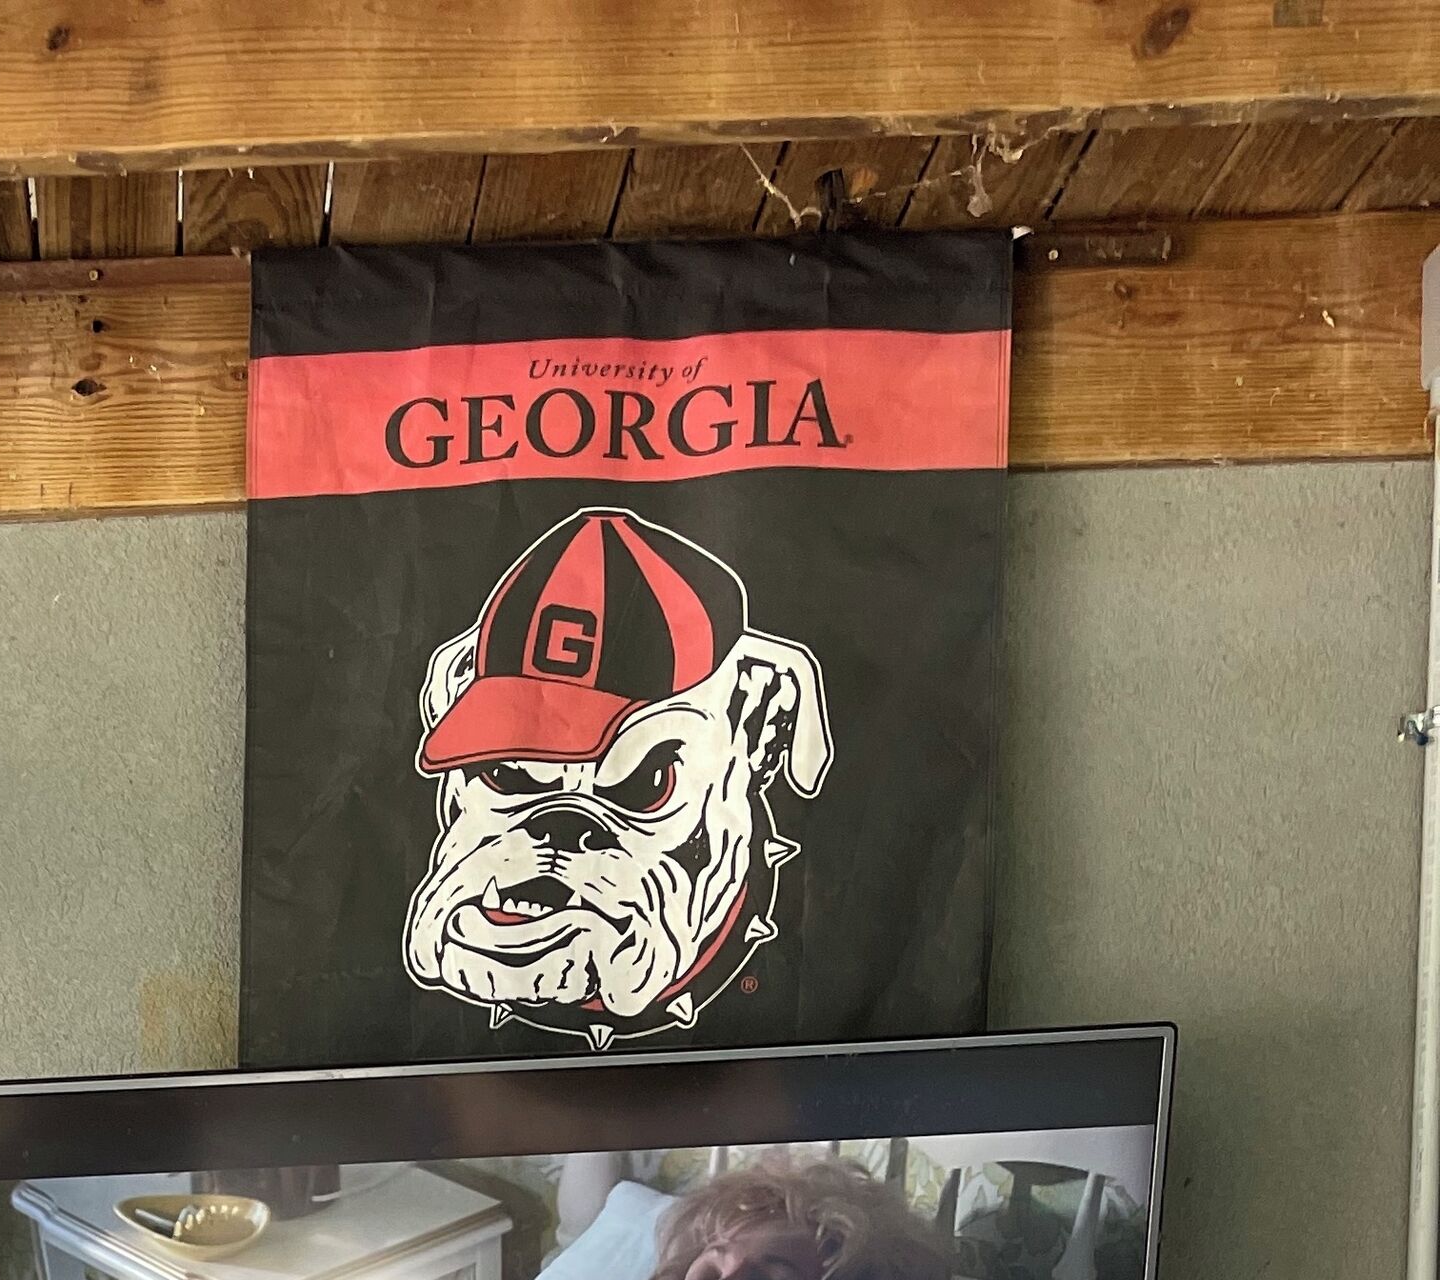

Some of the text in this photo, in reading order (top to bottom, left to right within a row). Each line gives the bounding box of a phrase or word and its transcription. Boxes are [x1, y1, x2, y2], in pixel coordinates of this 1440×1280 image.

[529, 356, 709, 387] University of
[384, 377, 847, 469] GEORGIA
[532, 603, 597, 678] G
